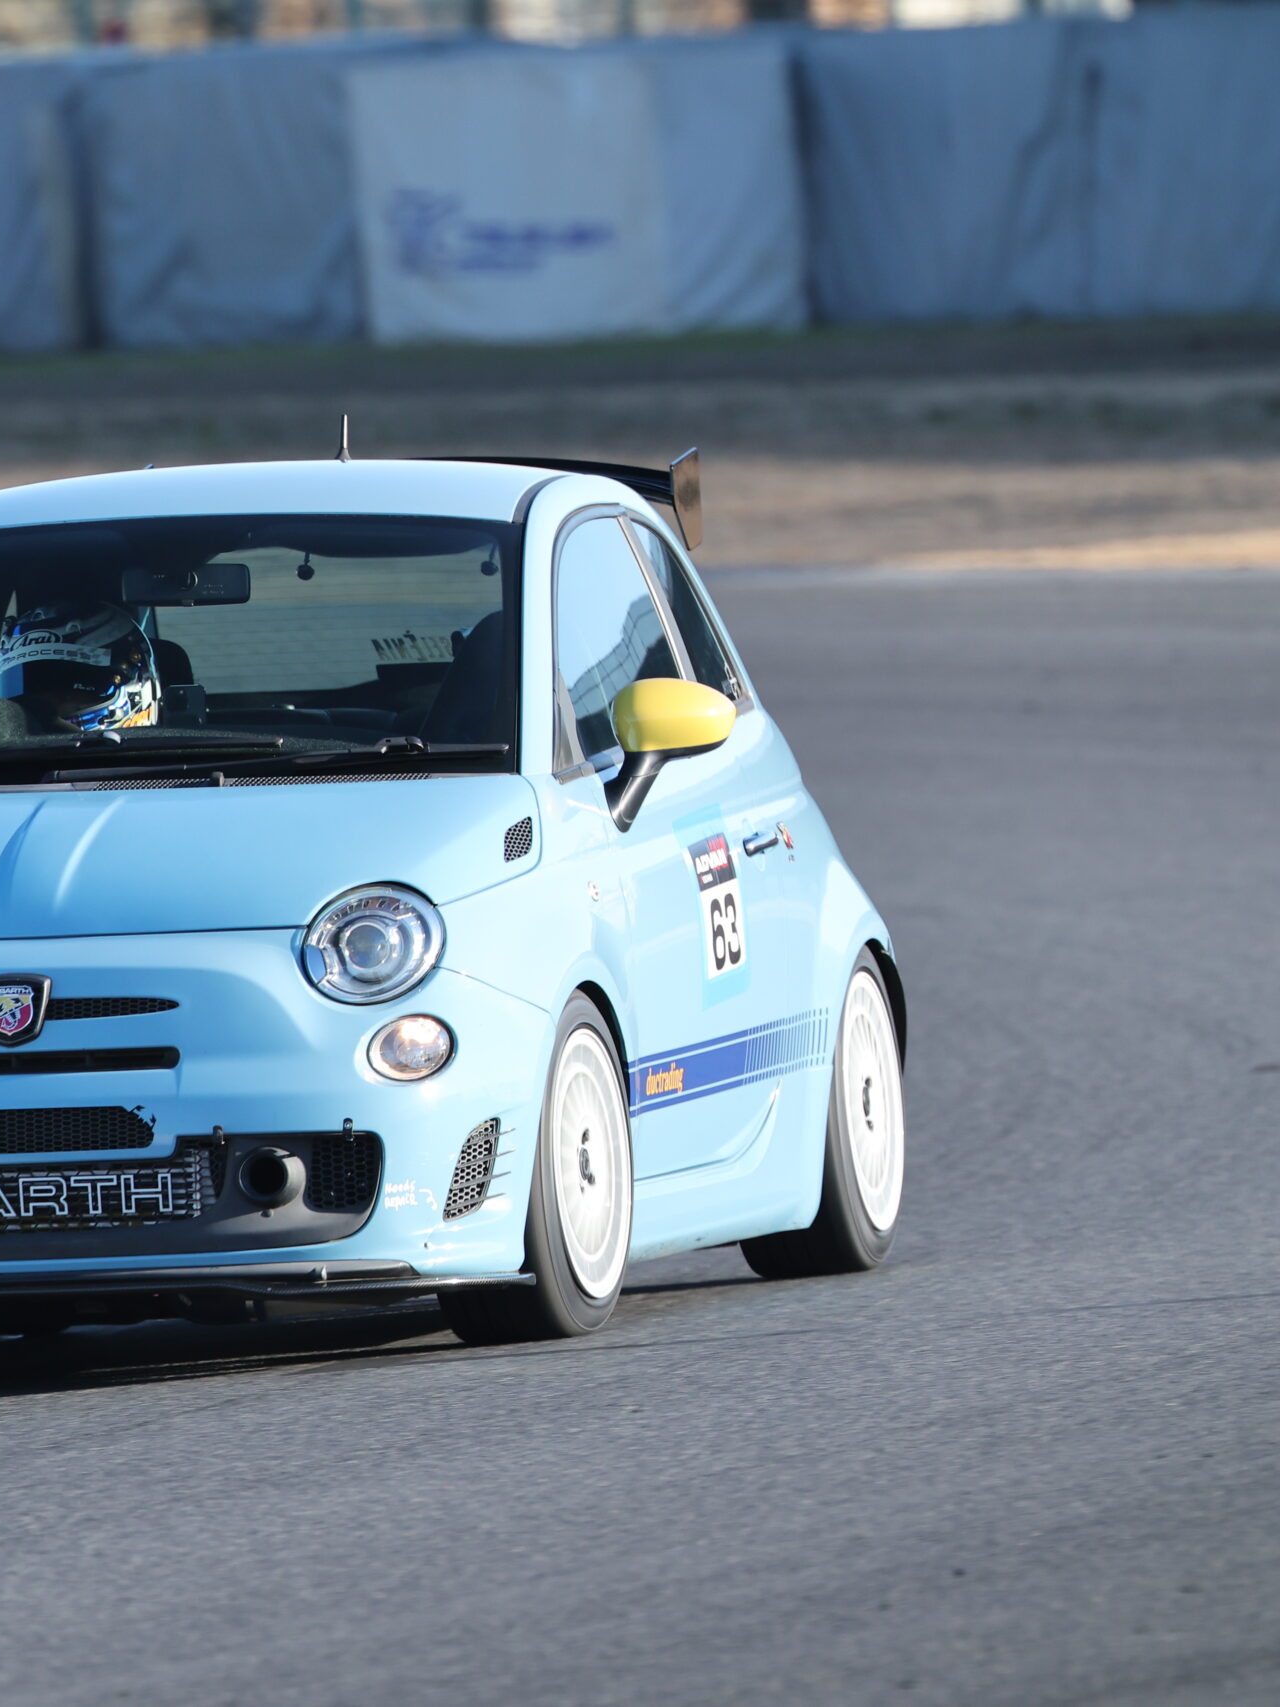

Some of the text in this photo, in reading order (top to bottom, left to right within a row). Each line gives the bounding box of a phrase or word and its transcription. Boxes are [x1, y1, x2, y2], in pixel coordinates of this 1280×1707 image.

[20, 633, 53, 647] Arai
[695, 848, 728, 874] ADVAN
[710, 893, 741, 971] 63
